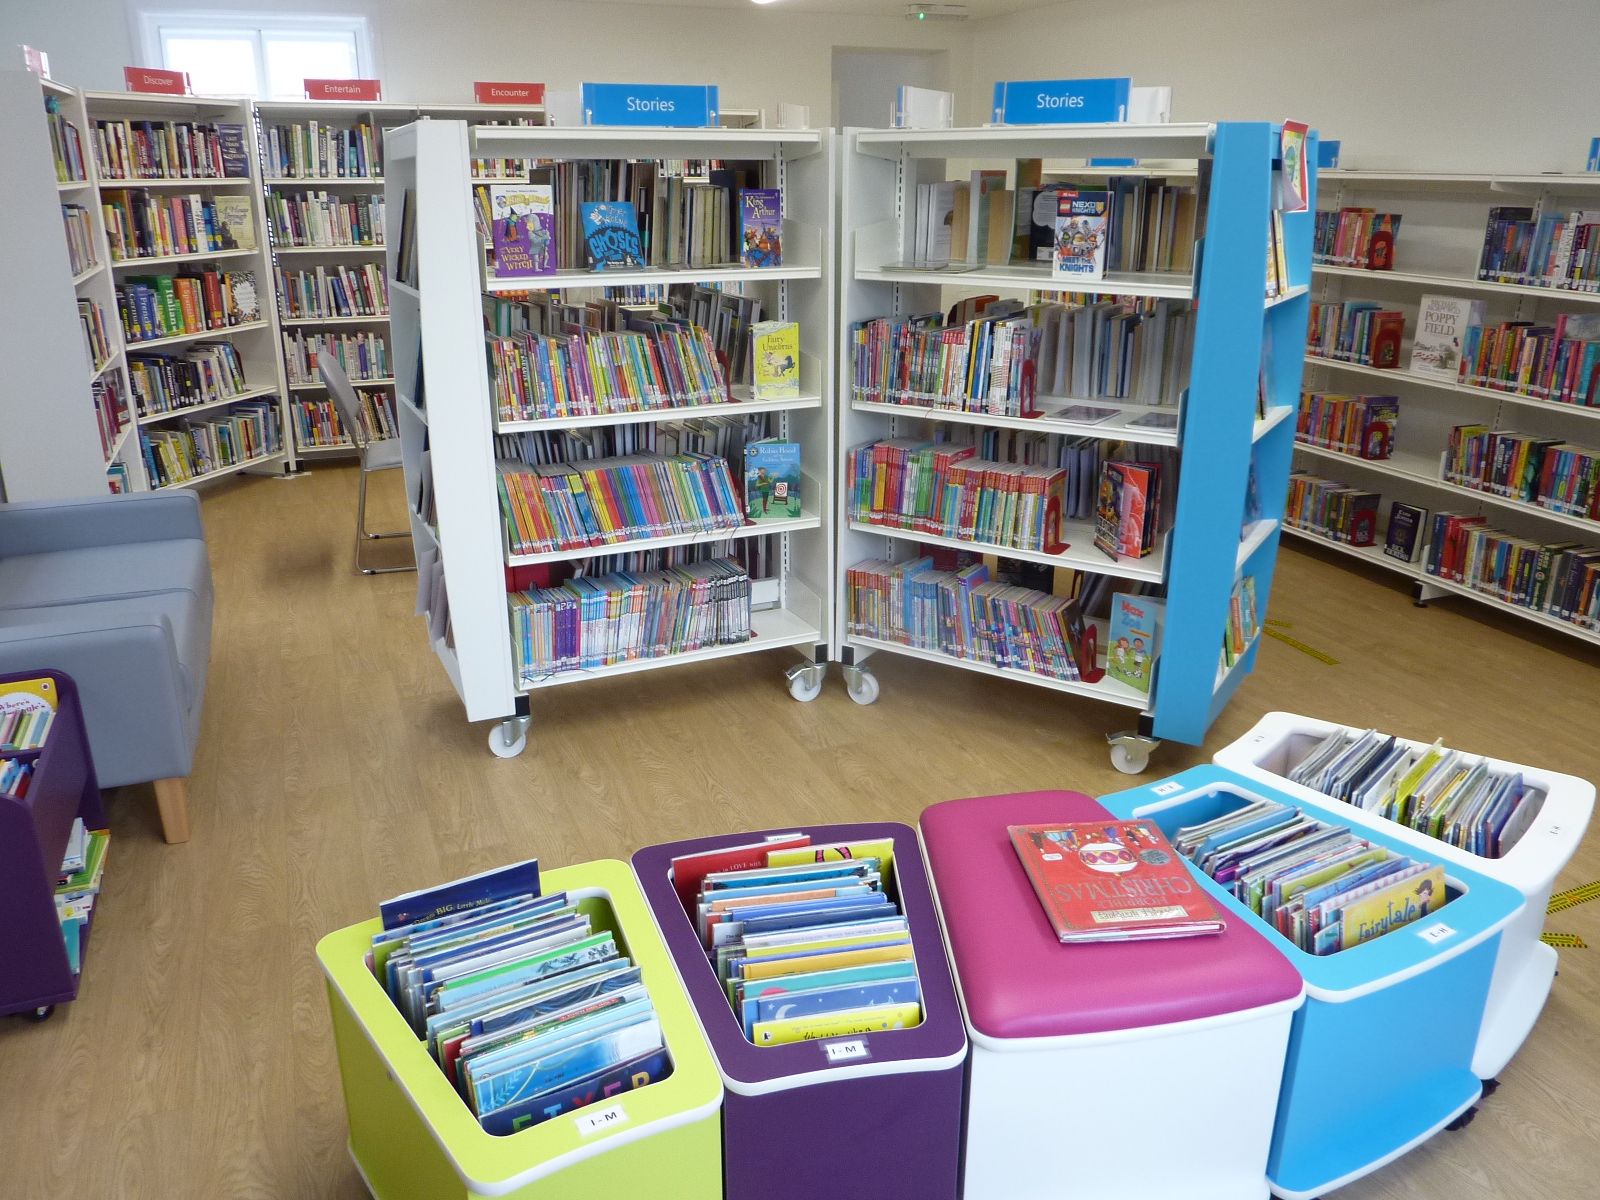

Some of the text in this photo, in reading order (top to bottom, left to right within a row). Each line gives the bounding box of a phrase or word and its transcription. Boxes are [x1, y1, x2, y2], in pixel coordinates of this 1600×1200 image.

[143, 73, 174, 87] Discover
[324, 83, 361, 95] Entertain
[491, 87, 529, 98] Encounter
[626, 96, 675, 112] Stories
[1036, 93, 1085, 109] Stories
[752, 206, 776, 219] Arthur
[505, 260, 534, 271] WITCH
[1424, 310, 1459, 325] POPPY
[1423, 322, 1455, 336] FIELD
[767, 334, 785, 343] Fairy
[762, 343, 793, 352] Unicorns
[760, 445, 796, 455] Robin Hood
[1055, 875, 1193, 902] CHRISTMAS
[1359, 896, 1417, 938] Fairytale
